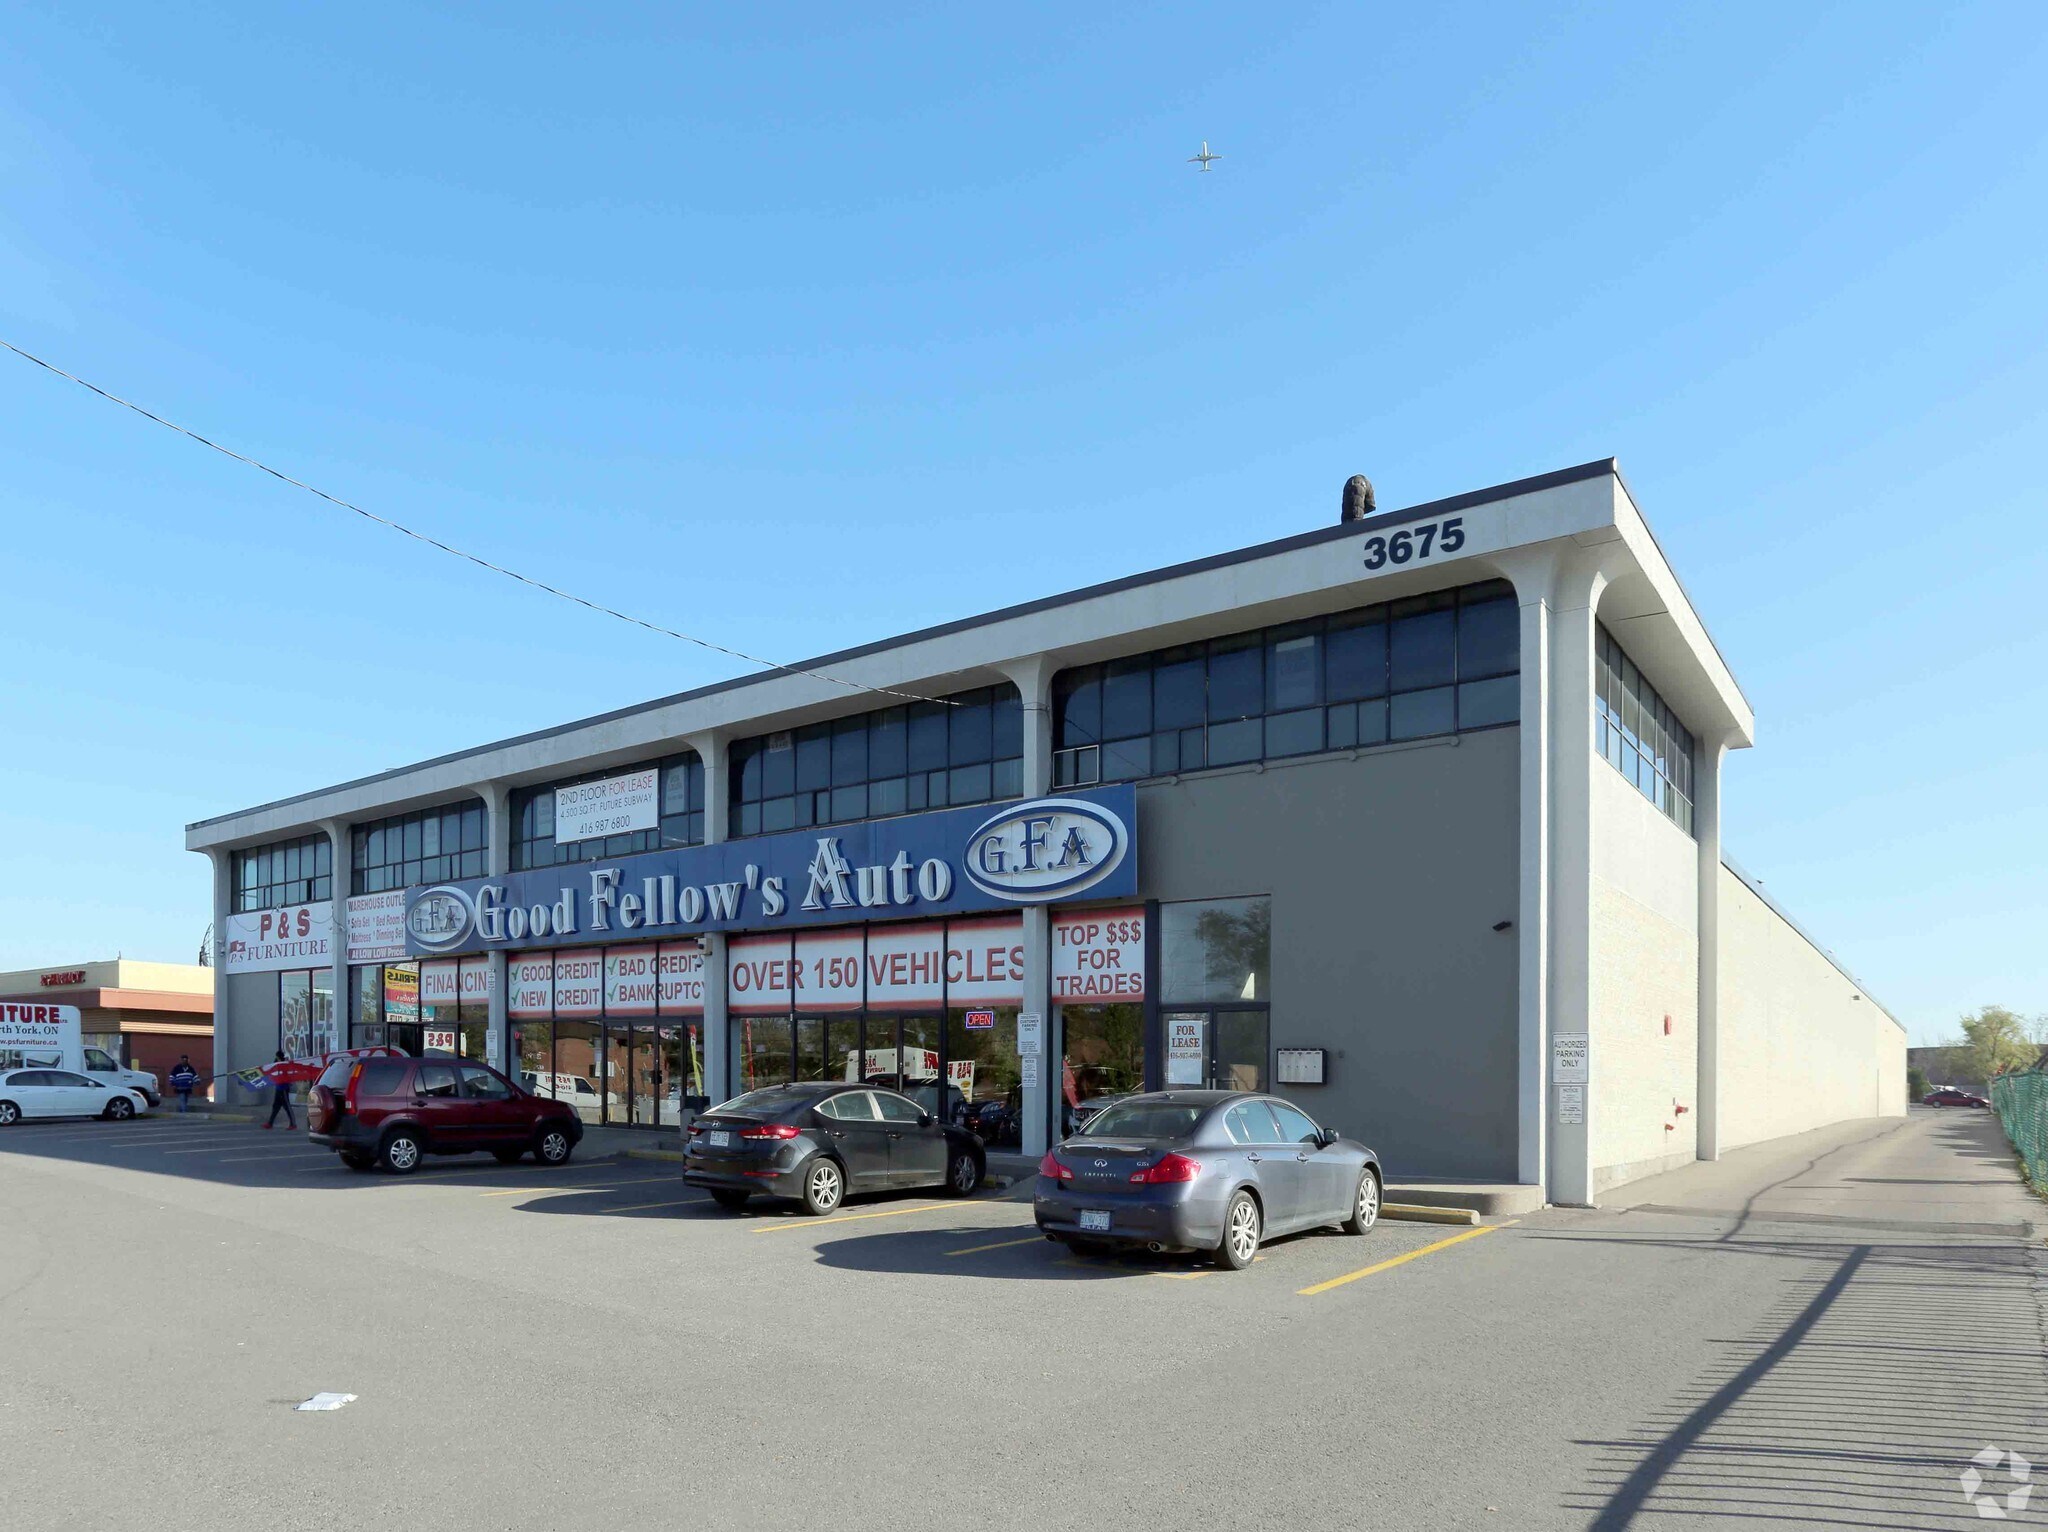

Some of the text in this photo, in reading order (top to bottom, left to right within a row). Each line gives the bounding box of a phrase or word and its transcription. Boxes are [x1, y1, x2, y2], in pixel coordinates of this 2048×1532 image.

[1364, 518, 1465, 570] 3675
[561, 791, 578, 805] 2ND
[581, 786, 607, 802] FLOOR
[609, 781, 625, 795] FOR
[628, 775, 653, 792] LEASE
[600, 799, 622, 811] FUTURE
[624, 793, 653, 807] SUBWAY
[579, 815, 631, 834] 416 987 6800
[475, 836, 955, 942] Good Fellow's Auto
[348, 897, 384, 912] WAREHOUSE
[260, 908, 310, 941] P & S
[1057, 920, 1141, 946] TOP $$$
[247, 939, 328, 961] FURNITURE
[1077, 949, 1121, 970] FOR
[521, 962, 600, 982] GOOD CREDIT
[619, 958, 646, 977] BAD
[732, 945, 1023, 992] OVER 150 VEHICLES
[1056, 972, 1142, 995] TRADES
[521, 988, 600, 1007] NEW CREDIT
[967, 1014, 992, 1026] OPEN
[44, 1026, 59, 1034] ON
[1176, 1026, 1195, 1035] FOR
[1172, 1038, 1200, 1047] LEASE
[1554, 1040, 1587, 1048] AUTHORIZED
[1556, 1050, 1585, 1058] PARKING
[1562, 1059, 1579, 1067] ONLY
